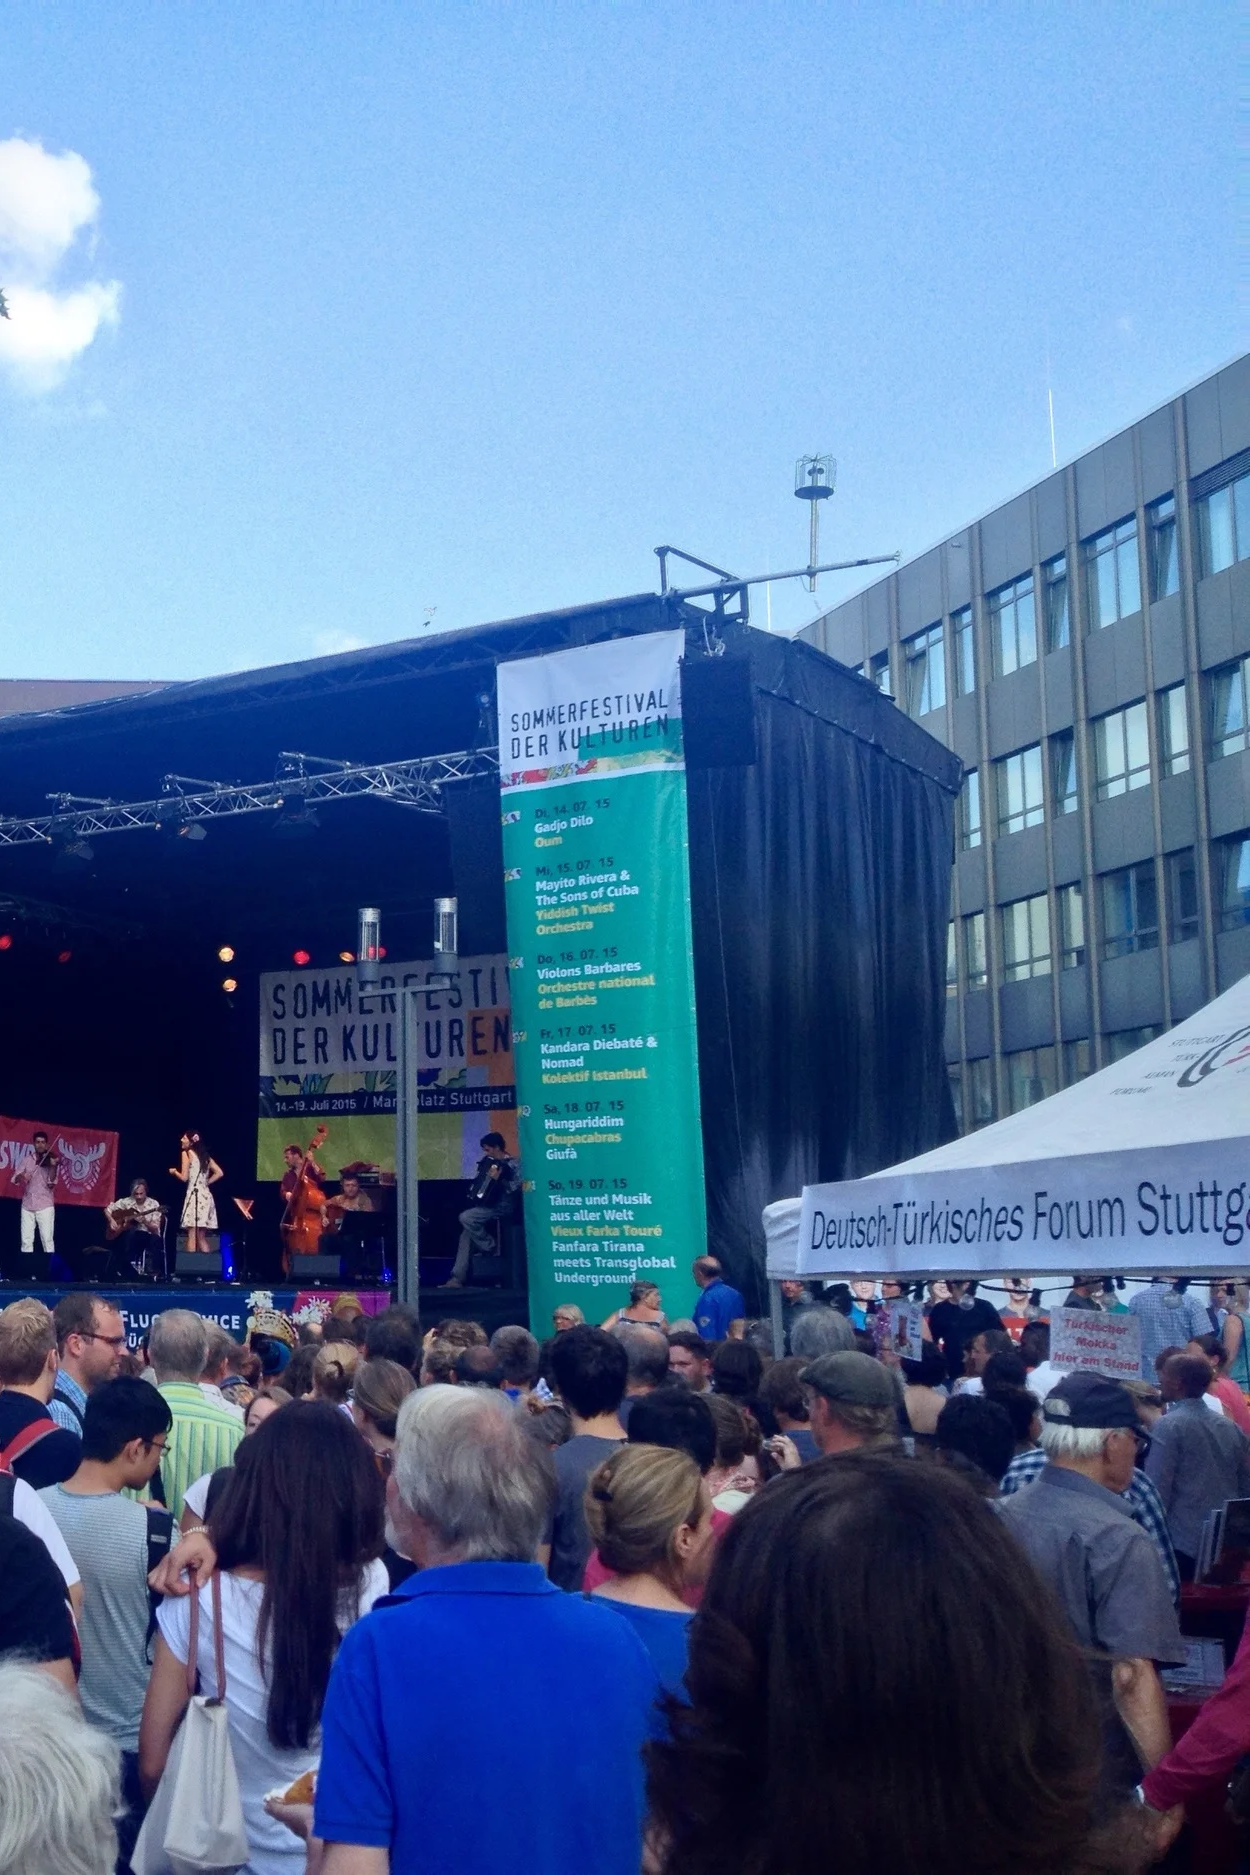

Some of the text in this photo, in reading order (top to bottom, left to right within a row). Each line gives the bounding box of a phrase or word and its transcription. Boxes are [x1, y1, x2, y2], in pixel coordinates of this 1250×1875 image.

[511, 688, 668, 733] SOMMERFESTIVAL
[511, 713, 669, 760] DER KULTUREN
[534, 815, 594, 834] Gadjo Dilo
[598, 857, 614, 868] 15
[535, 869, 631, 893] Mayito Rivera &
[535, 884, 639, 906] The Sons of Cuba
[581, 901, 615, 915] Twist
[536, 920, 594, 935] Orchestra
[537, 961, 642, 980] Violons Barbares
[538, 973, 656, 995] Orchestre national
[538, 998, 553, 1010] de
[601, 1023, 616, 1034] 15
[272, 1014, 511, 1065] DER KULUREN
[540, 1035, 658, 1054] Kandara Diebaté &
[541, 1055, 584, 1069] Nomad
[310, 1098, 329, 1110] Juli
[373, 1091, 445, 1108] Marlatz
[450, 1089, 512, 1106] Stuttgart
[544, 1116, 624, 1132] Hungariddim
[545, 1132, 622, 1147] Chupacabras
[612, 1178, 627, 1189] 15
[549, 1192, 652, 1206] Tänze und Musik
[550, 1209, 634, 1221] aus aller Welt
[811, 1180, 1250, 1250] Deutsch-Türkisches Forum Stuttg
[550, 1224, 662, 1237] Vieux Farka Touré
[552, 1240, 645, 1252] Fanfara Tirana
[553, 1256, 676, 1272] meets Transglobal
[554, 1272, 636, 1287] Underground
[1053, 1352, 1140, 1371] hier am Stand
